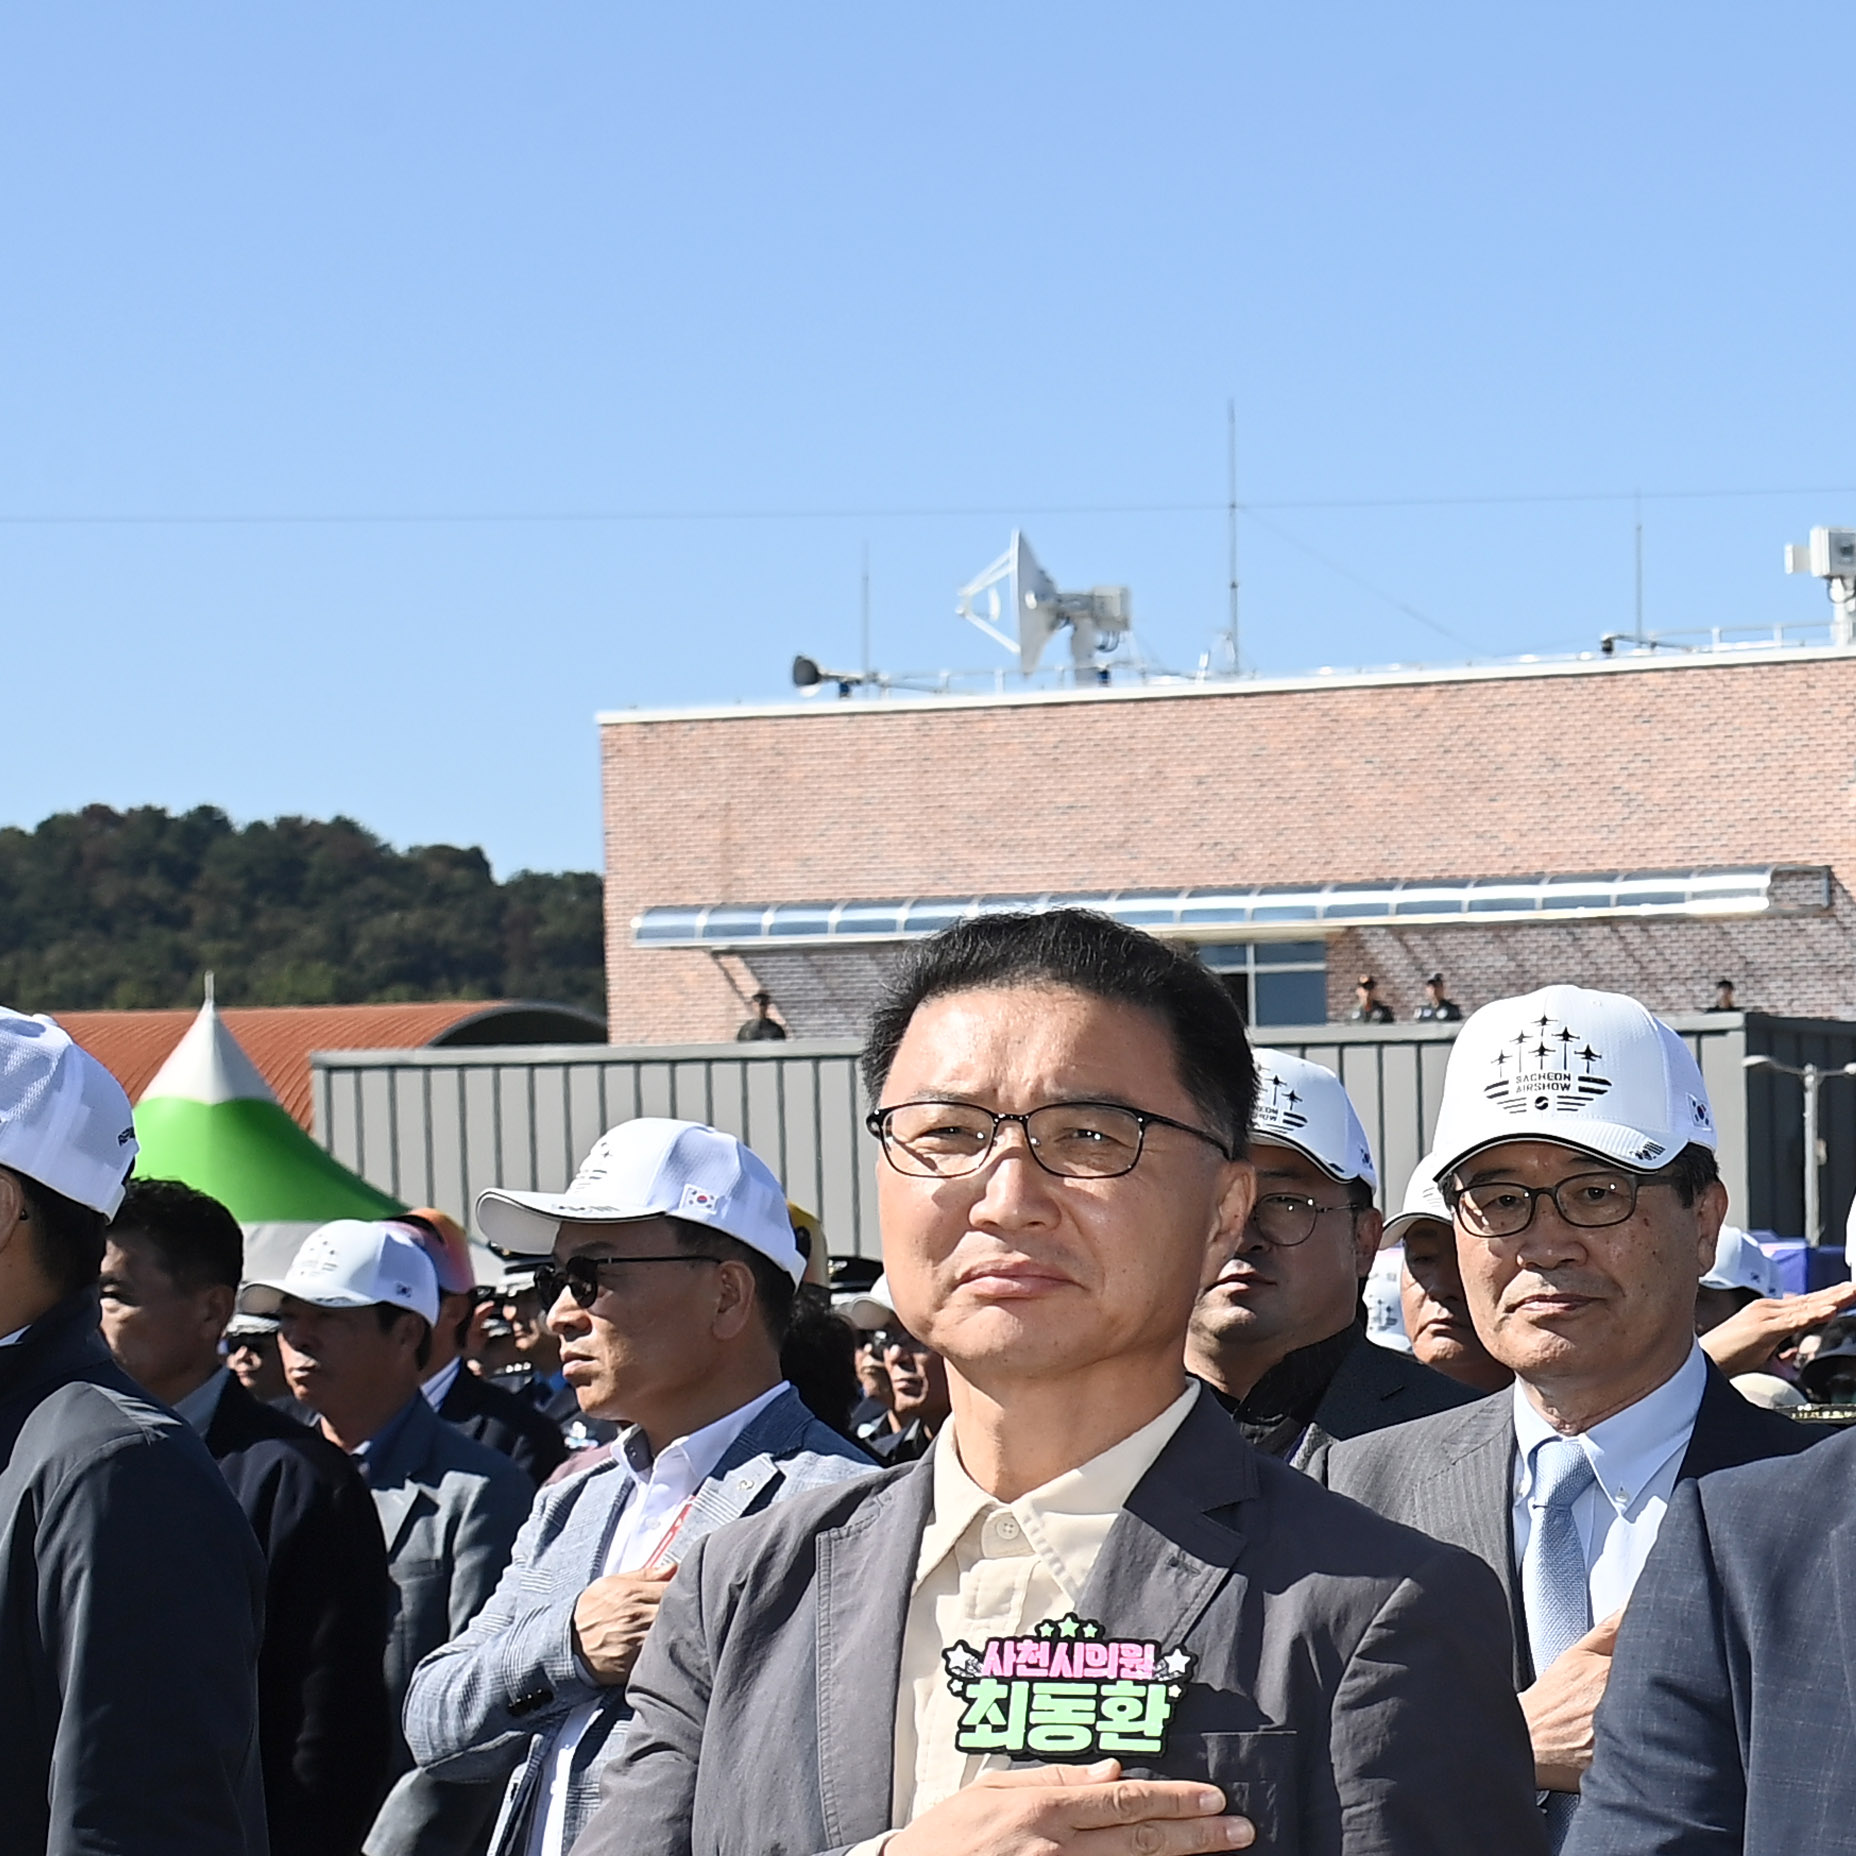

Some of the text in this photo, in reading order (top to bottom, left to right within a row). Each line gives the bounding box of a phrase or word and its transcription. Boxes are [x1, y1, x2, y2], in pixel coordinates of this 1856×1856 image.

[1515, 1072, 1572, 1083] SACHEON
[1515, 1082, 1572, 1093] AIRSHOW
[981, 1639, 1156, 1680] 사천시의원
[957, 1679, 1171, 1752] 최동환
